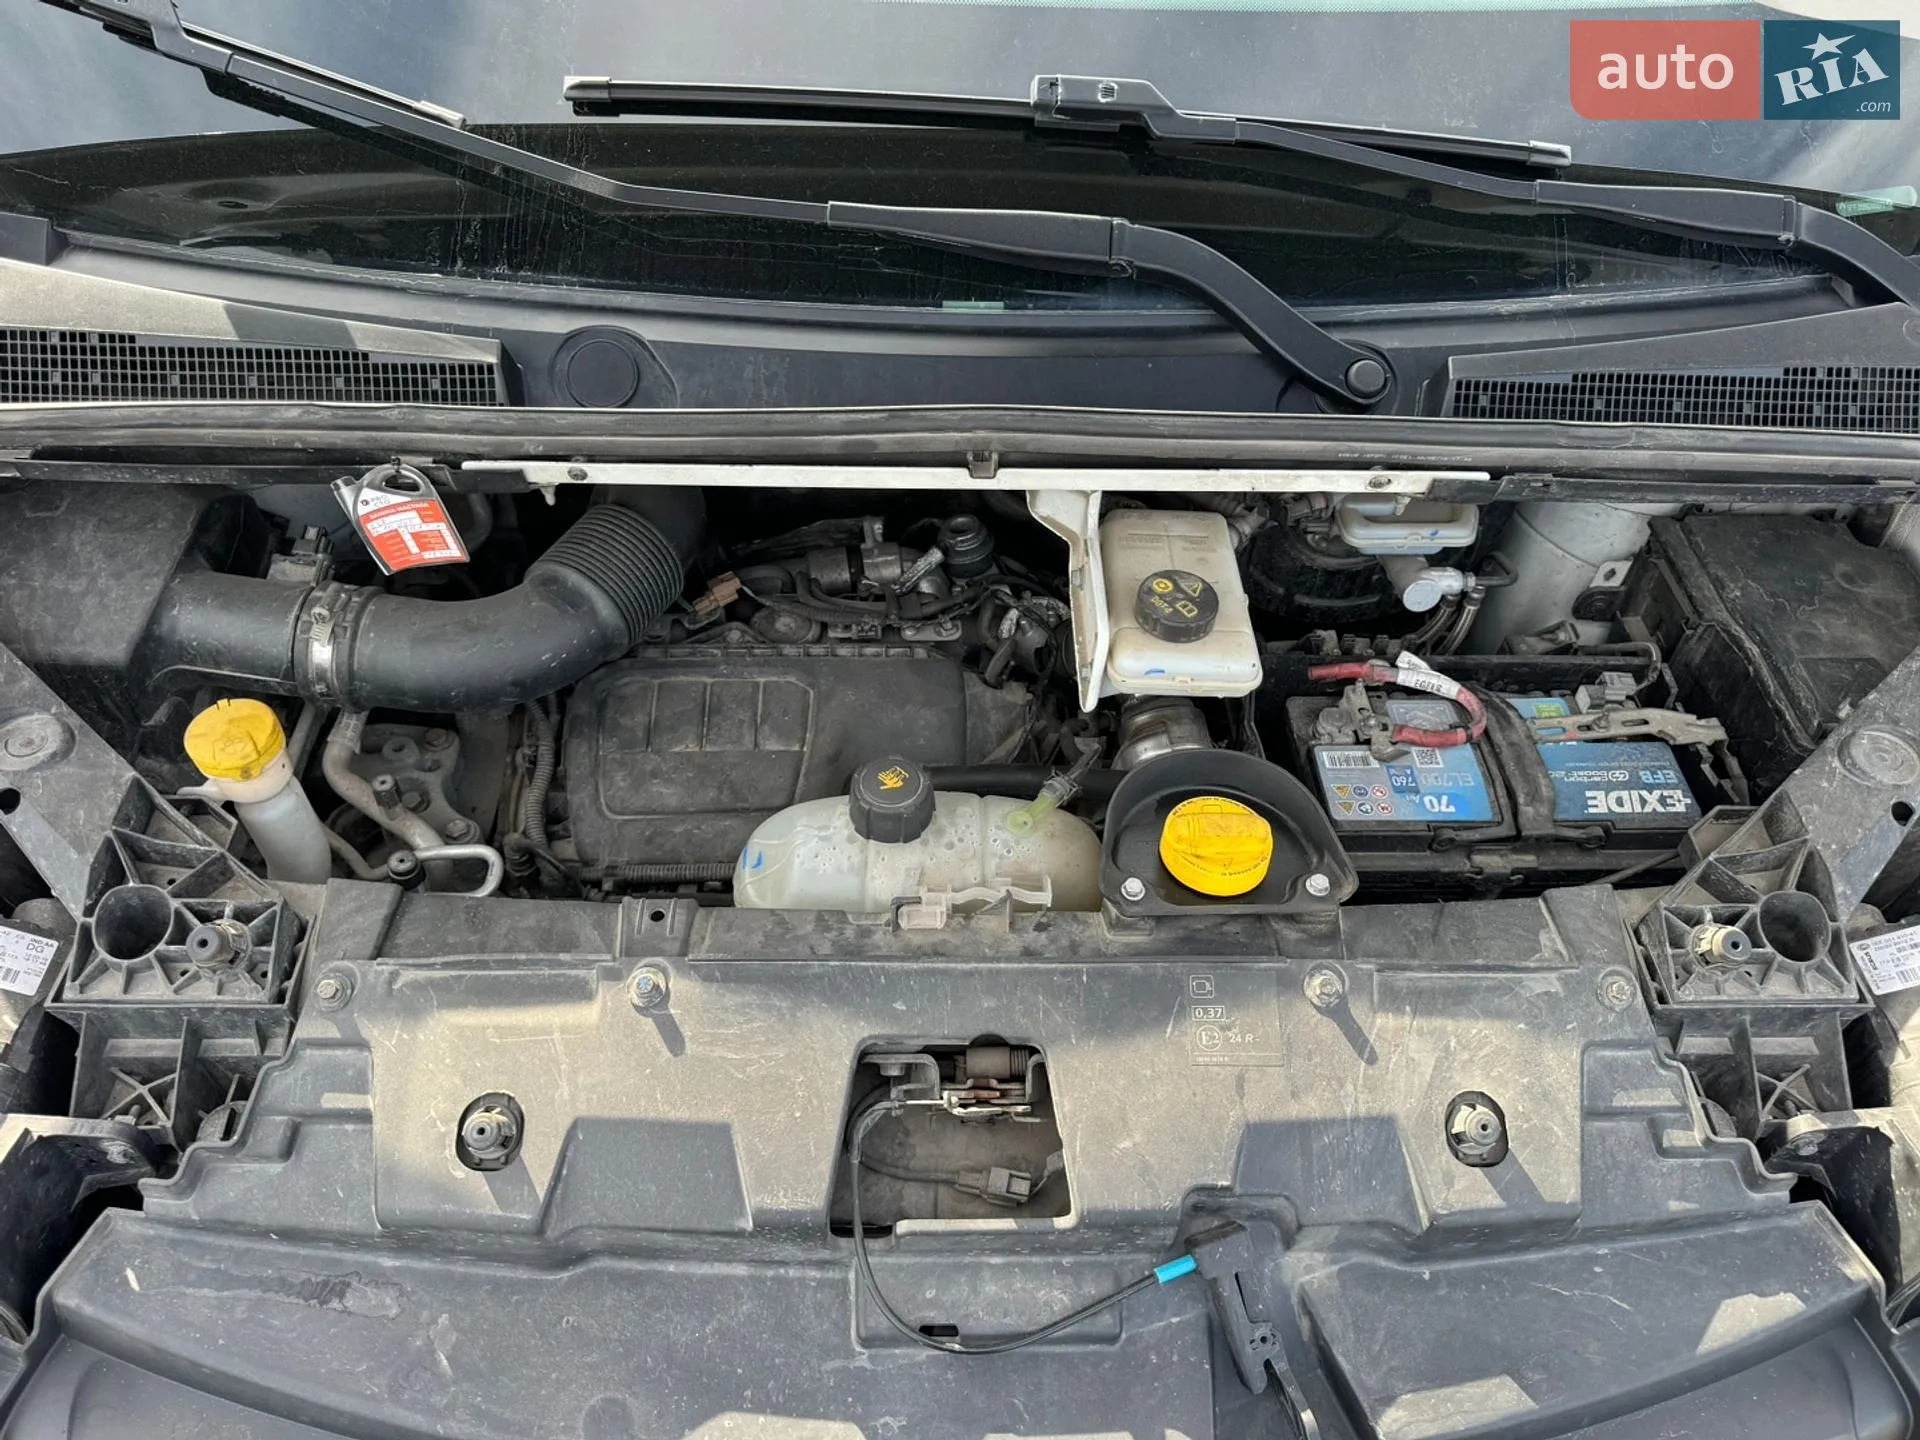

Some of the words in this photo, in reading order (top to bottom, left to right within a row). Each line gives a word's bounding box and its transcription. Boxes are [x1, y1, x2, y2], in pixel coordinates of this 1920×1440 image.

[1392, 775, 1416, 787] 760
[1639, 769, 1678, 784] EFB
[1423, 795, 1456, 812] 70
[1585, 789, 1692, 813] EXIDE
[1195, 1008, 1223, 1019] 0,37
